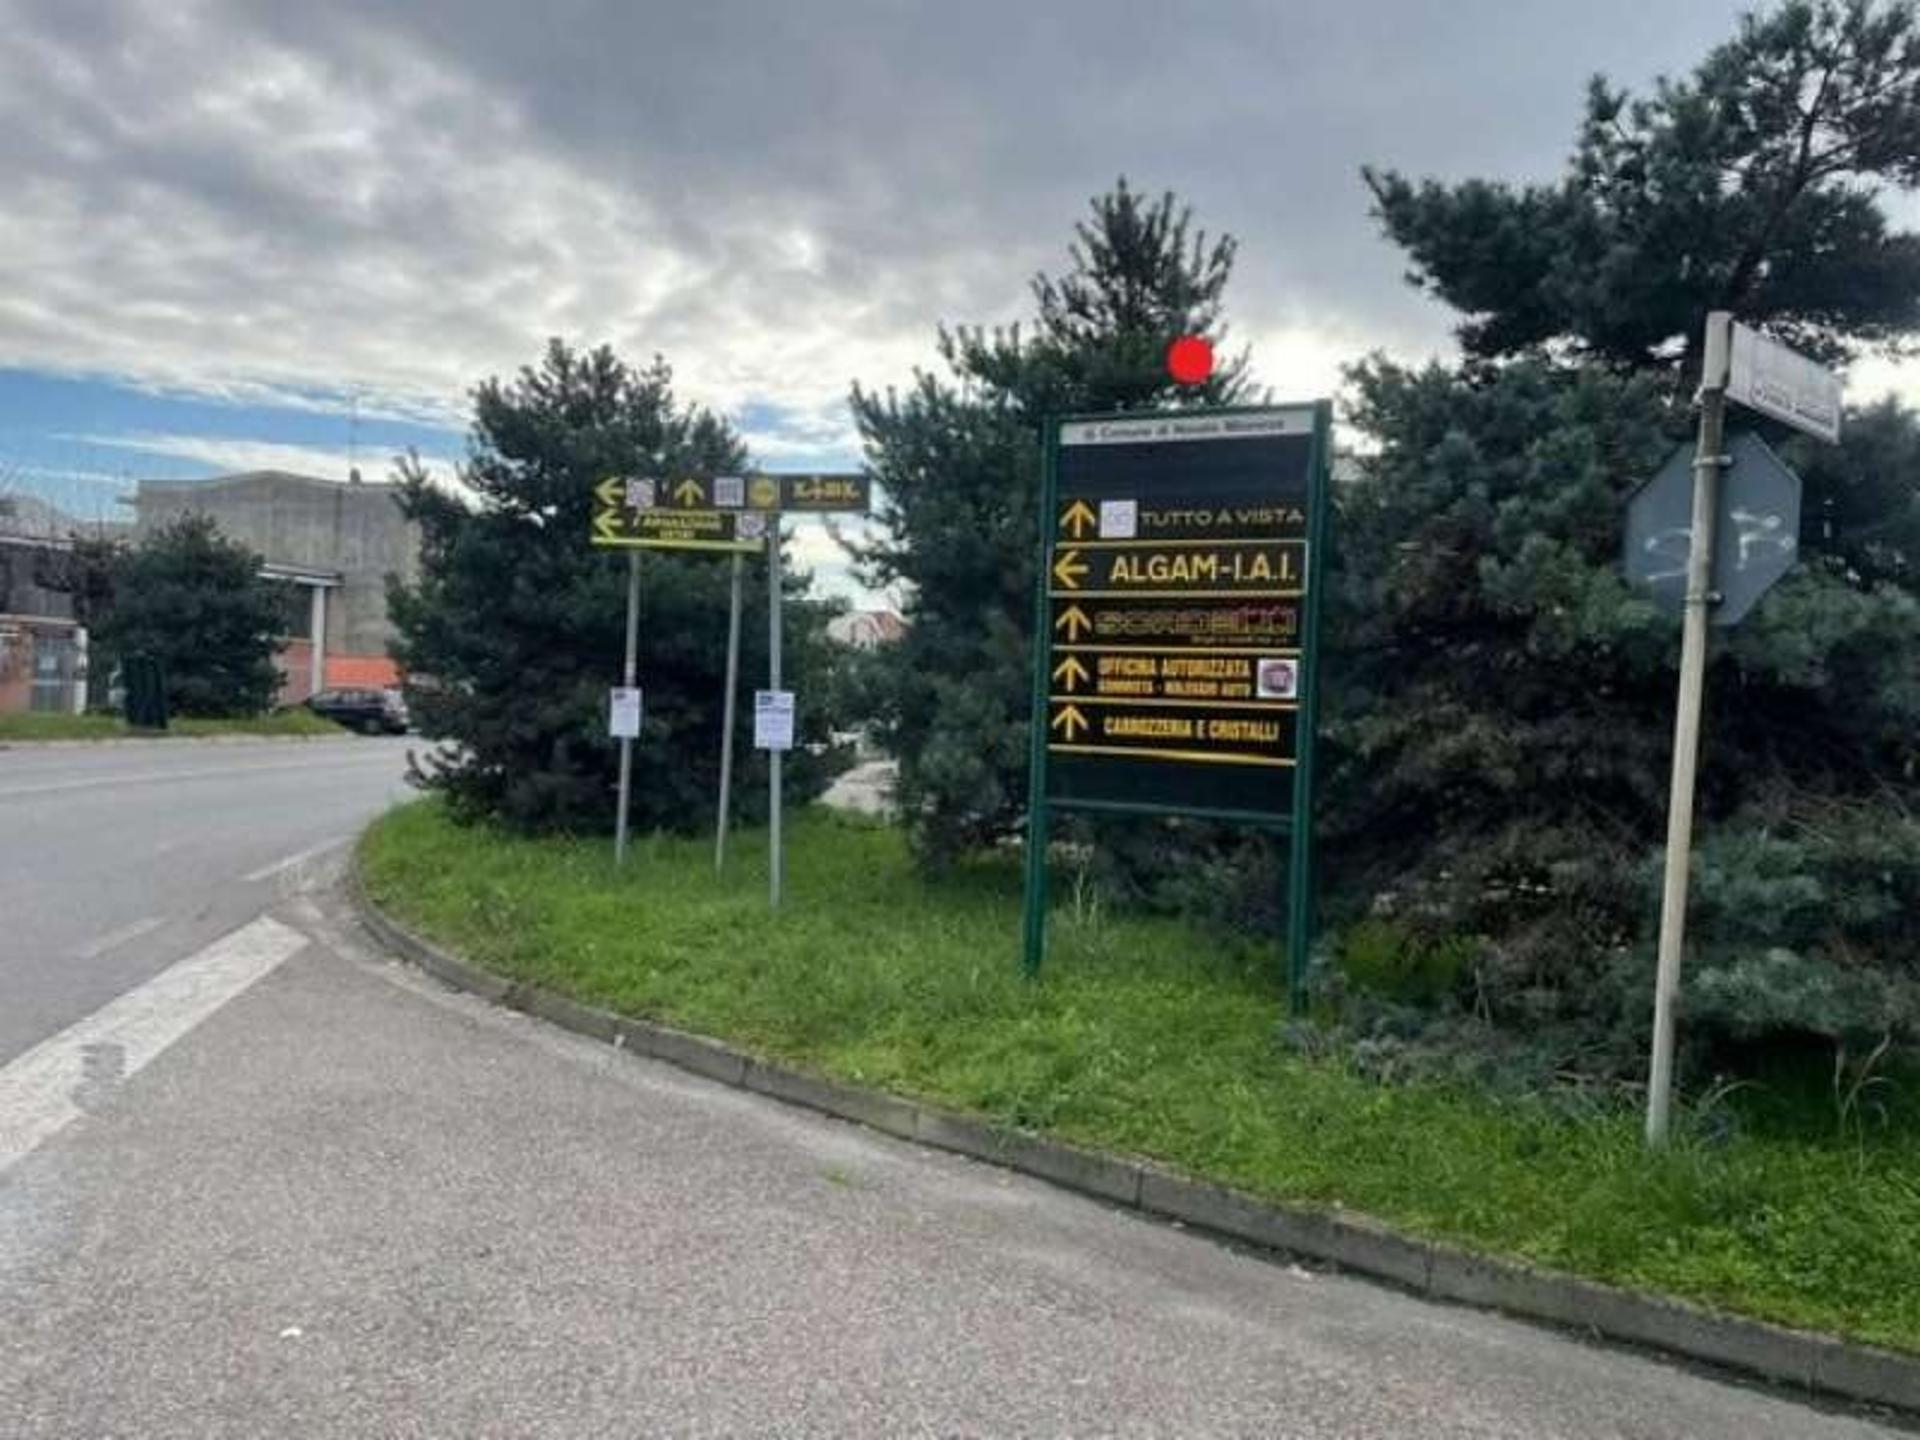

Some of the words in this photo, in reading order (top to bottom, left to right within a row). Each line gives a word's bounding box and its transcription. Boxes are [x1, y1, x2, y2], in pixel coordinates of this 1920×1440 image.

[1141, 510, 1211, 527] TUTTO
[1216, 508, 1233, 525] A
[1234, 507, 1305, 524] VISTA
[1109, 551, 1297, 583] ALGAM-I.A.I.
[1098, 656, 1156, 676] OFFICINA
[1161, 657, 1250, 679] AUTORIZZATA
[1103, 715, 1193, 737] CARROZZERIA
[1197, 718, 1204, 740] E
[1208, 718, 1280, 743] CRISTALLI
